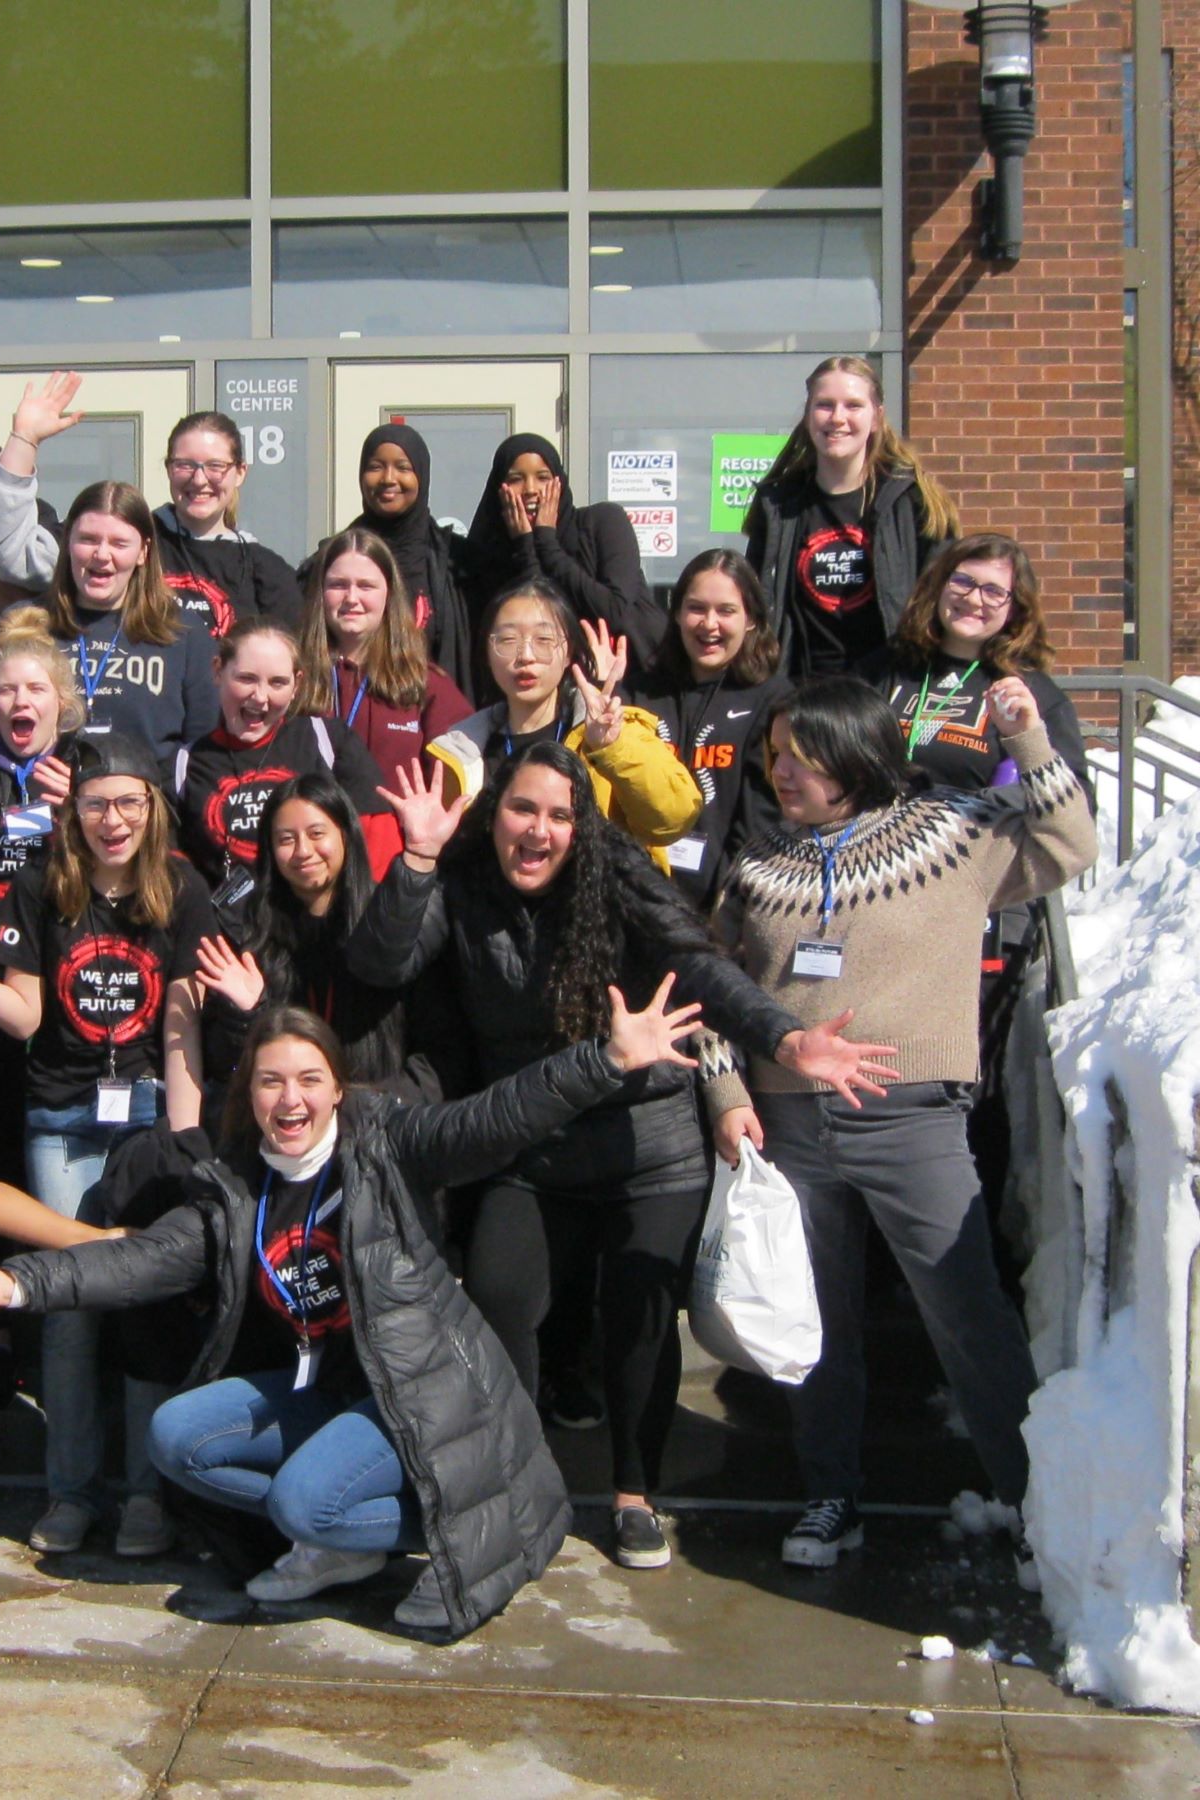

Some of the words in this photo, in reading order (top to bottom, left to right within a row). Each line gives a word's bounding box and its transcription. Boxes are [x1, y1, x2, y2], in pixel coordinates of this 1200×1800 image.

[226, 379, 298, 394] COLLEGE
[231, 397, 294, 412] CENTER
[239, 425, 285, 465] 18
[613, 455, 671, 468] NOTICE
[626, 511, 671, 524] OTICE
[815, 552, 837, 563] WE
[839, 550, 864, 562] ARE
[826, 562, 851, 574] THE
[815, 573, 864, 586] FUTURE
[936, 731, 989, 753] BASKETBALL
[243, 802, 265, 815] TH
[231, 816, 261, 831] FUT
[2, 847, 27, 860] THE
[80, 969, 103, 985] WE
[108, 972, 139, 985] ARE
[79, 998, 136, 1011] FUTURE
[276, 1266, 300, 1283] WE
[294, 1276, 320, 1296] THE
